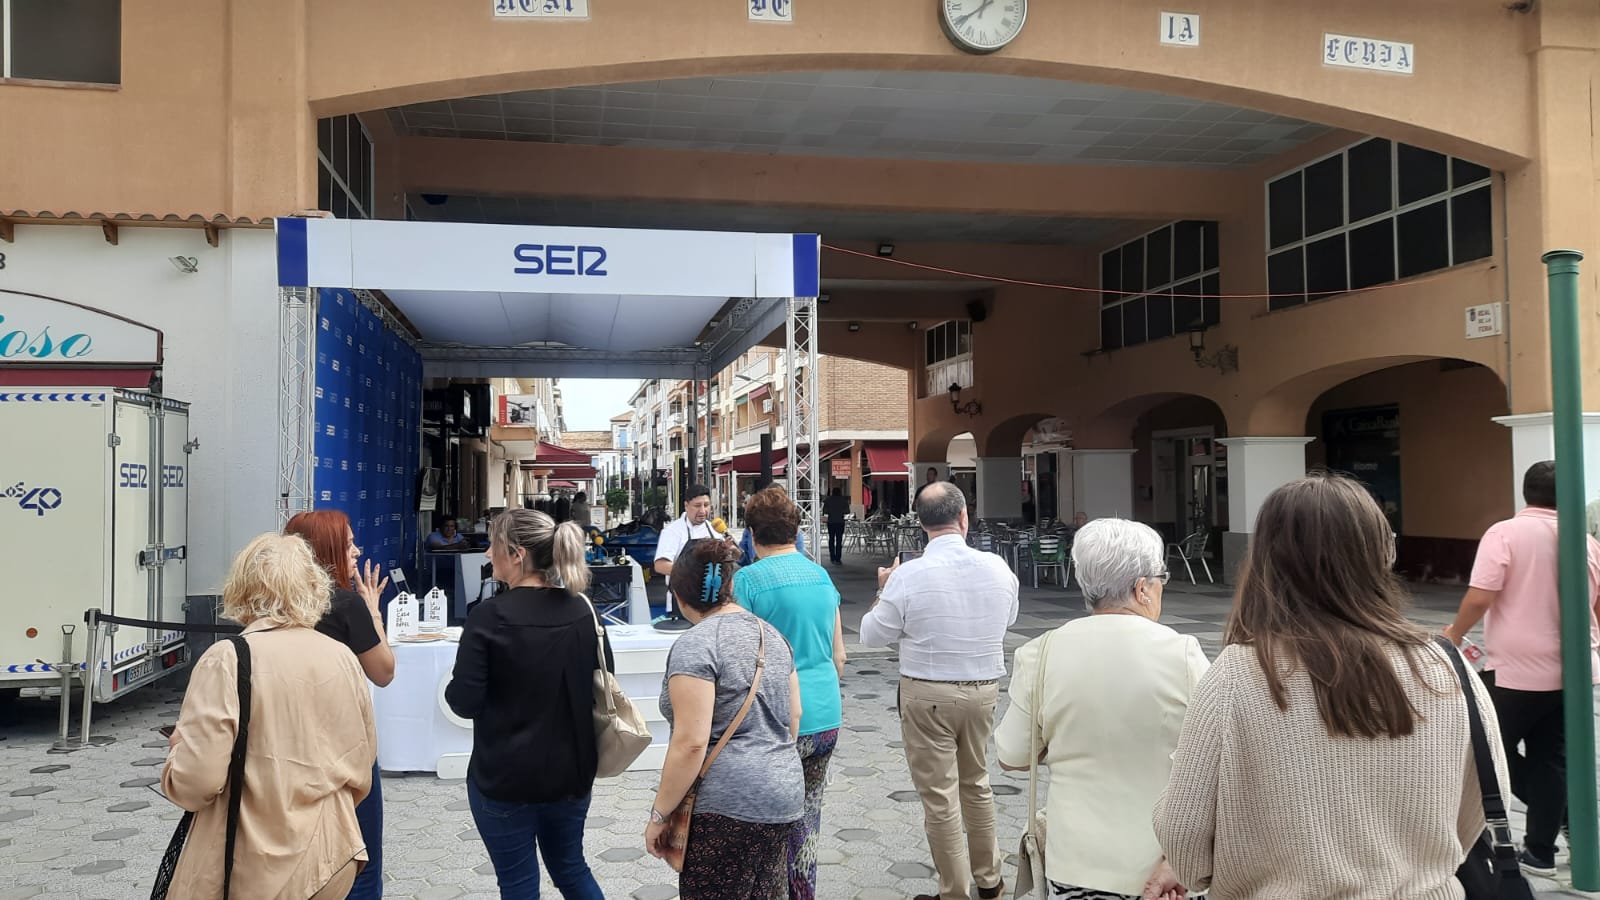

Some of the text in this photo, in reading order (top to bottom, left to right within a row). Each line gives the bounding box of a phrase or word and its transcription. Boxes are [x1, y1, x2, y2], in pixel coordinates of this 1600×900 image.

[1327, 39, 1410, 69] FERIA
[514, 244, 607, 276] SER
[0, 315, 92, 358] oso
[120, 463, 147, 488] SER
[19, 488, 61, 516] 40
